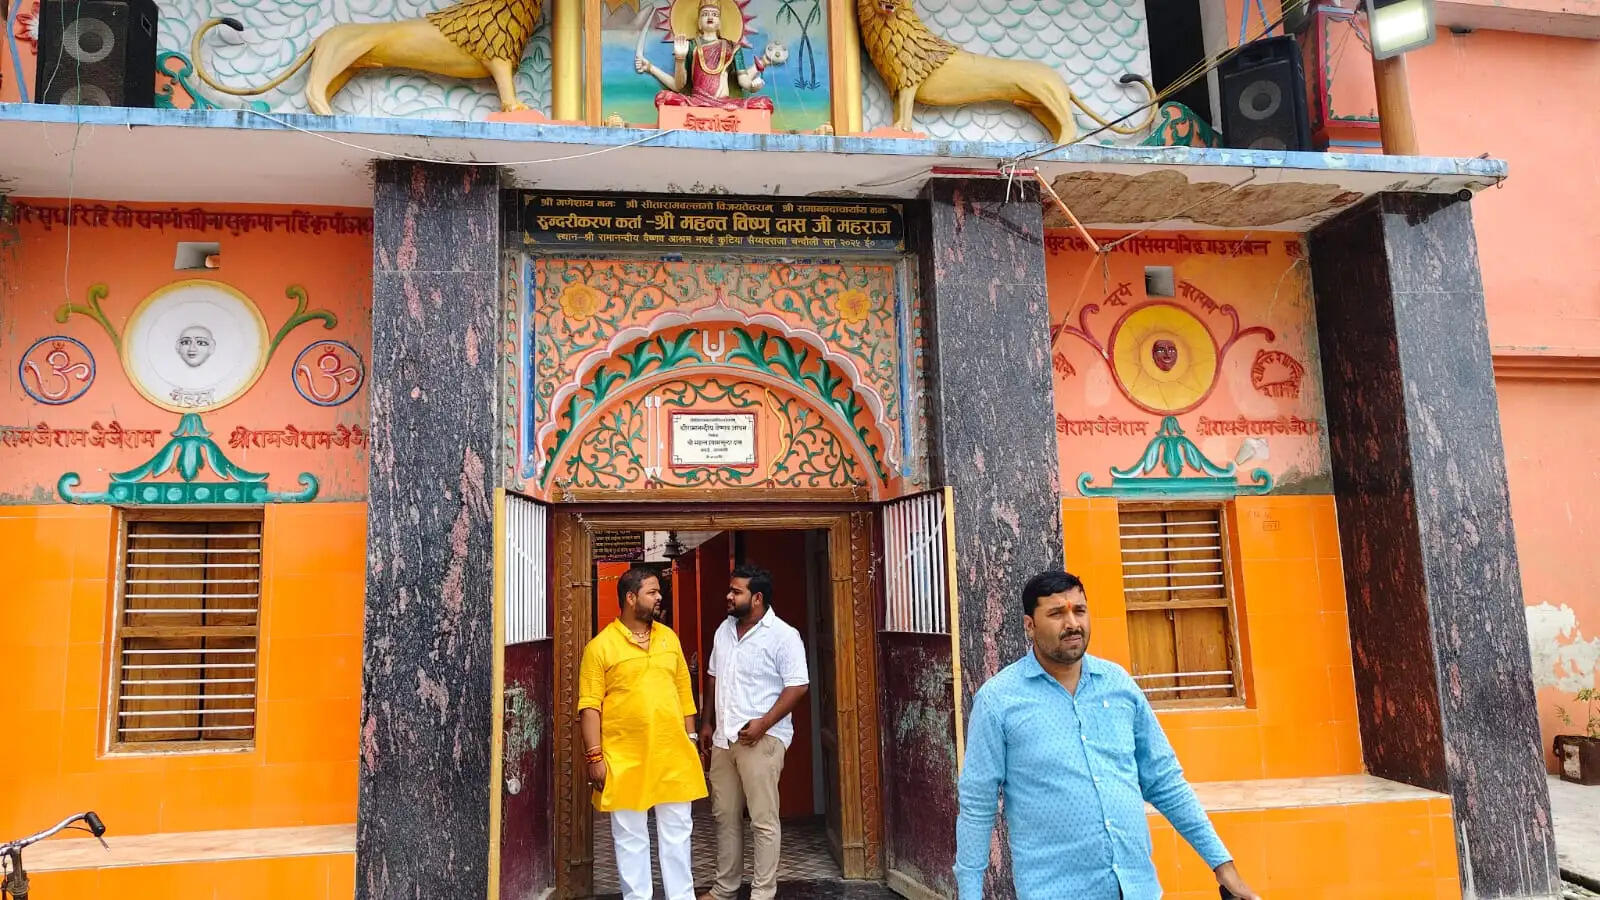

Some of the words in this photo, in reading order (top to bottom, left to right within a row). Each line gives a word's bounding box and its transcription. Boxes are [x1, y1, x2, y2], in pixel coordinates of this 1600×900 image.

[540, 197, 553, 207] श्री
[556, 197, 594, 208] गणेशाय
[597, 200, 616, 208] नमः
[625, 199, 638, 209] श्री
[782, 202, 794, 212] श्री
[870, 207, 888, 215] नमः
[536, 212, 613, 231] सुन्दरीकरण
[615, 214, 642, 229] कर्ता
[679, 215, 728, 231] महन्त
[732, 211, 771, 235] विष्णु
[775, 217, 807, 233] दास
[811, 214, 833, 233] जी
[837, 219, 893, 235] महराज
